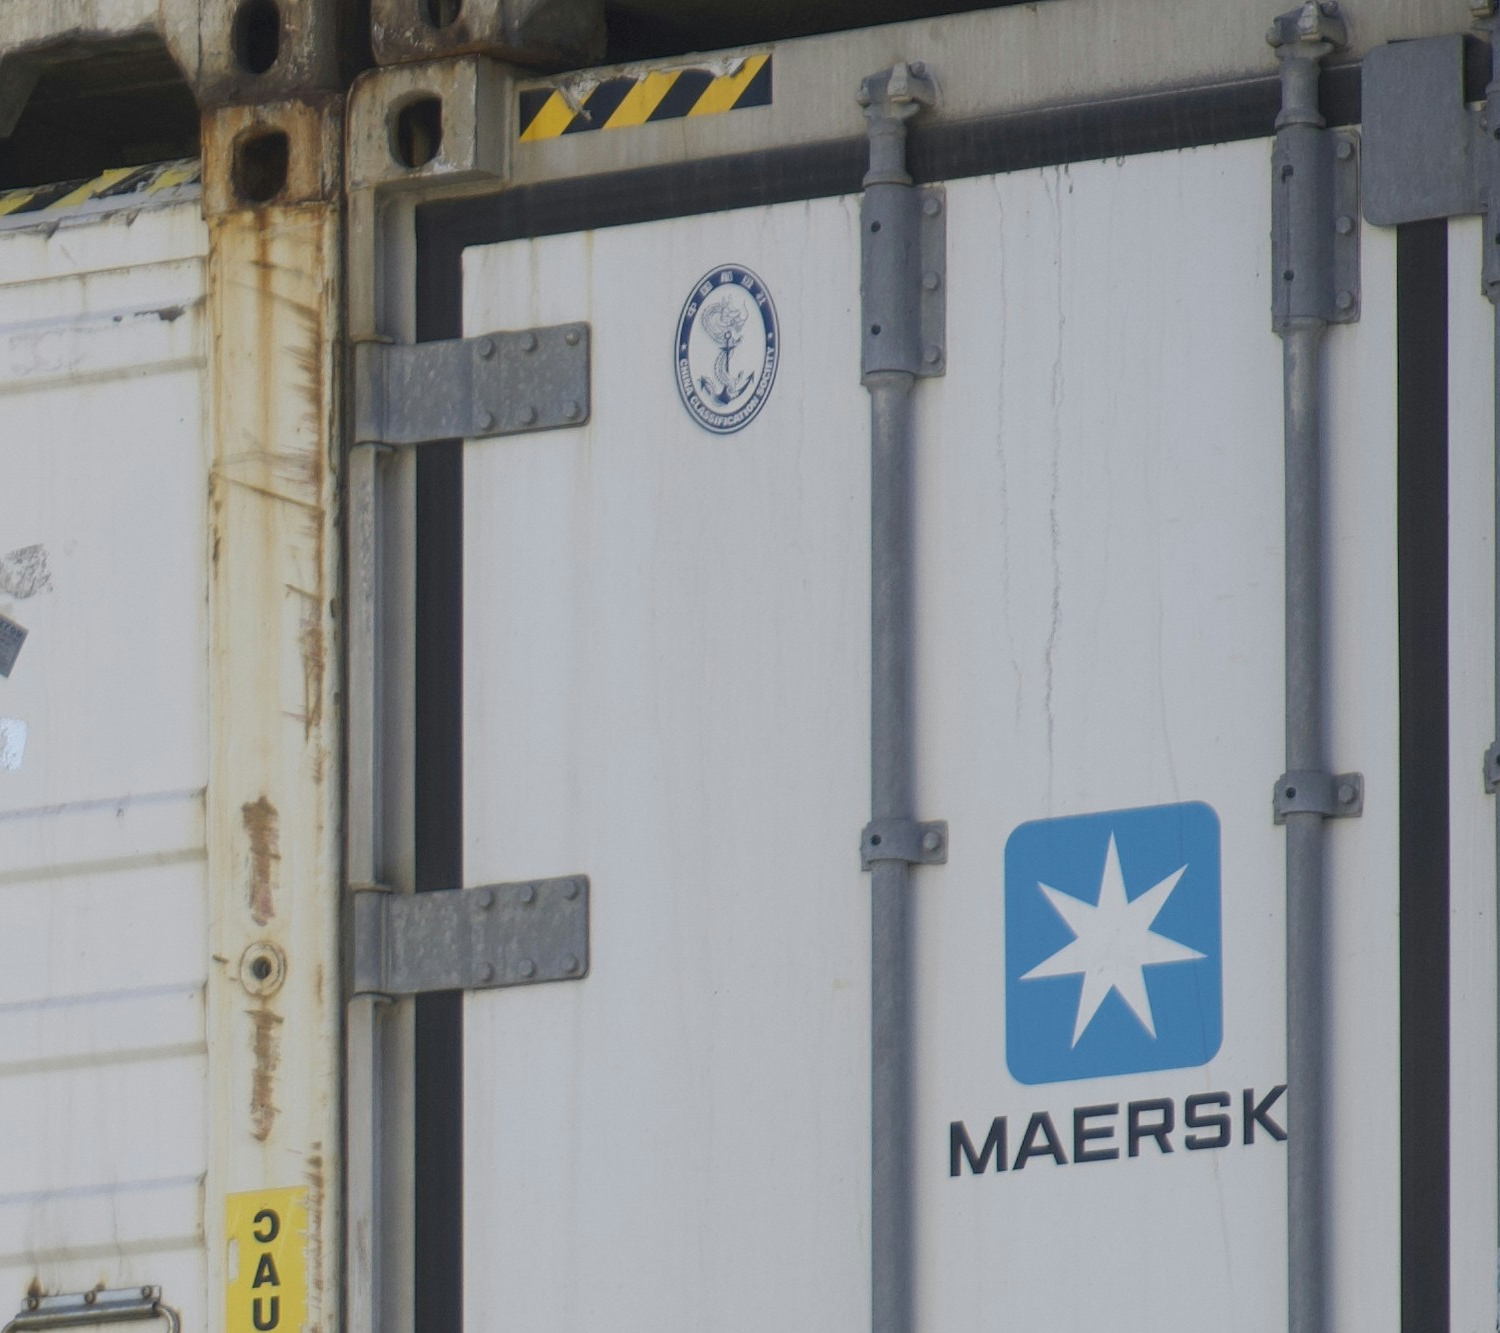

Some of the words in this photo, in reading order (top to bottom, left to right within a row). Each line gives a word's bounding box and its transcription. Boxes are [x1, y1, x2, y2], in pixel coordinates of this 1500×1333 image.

[680, 358, 693, 394] CHINA
[691, 393, 759, 427] CLASSIFICATION
[757, 347, 774, 396] SOCIETY
[948, 1084, 1288, 1177] MAERSK
